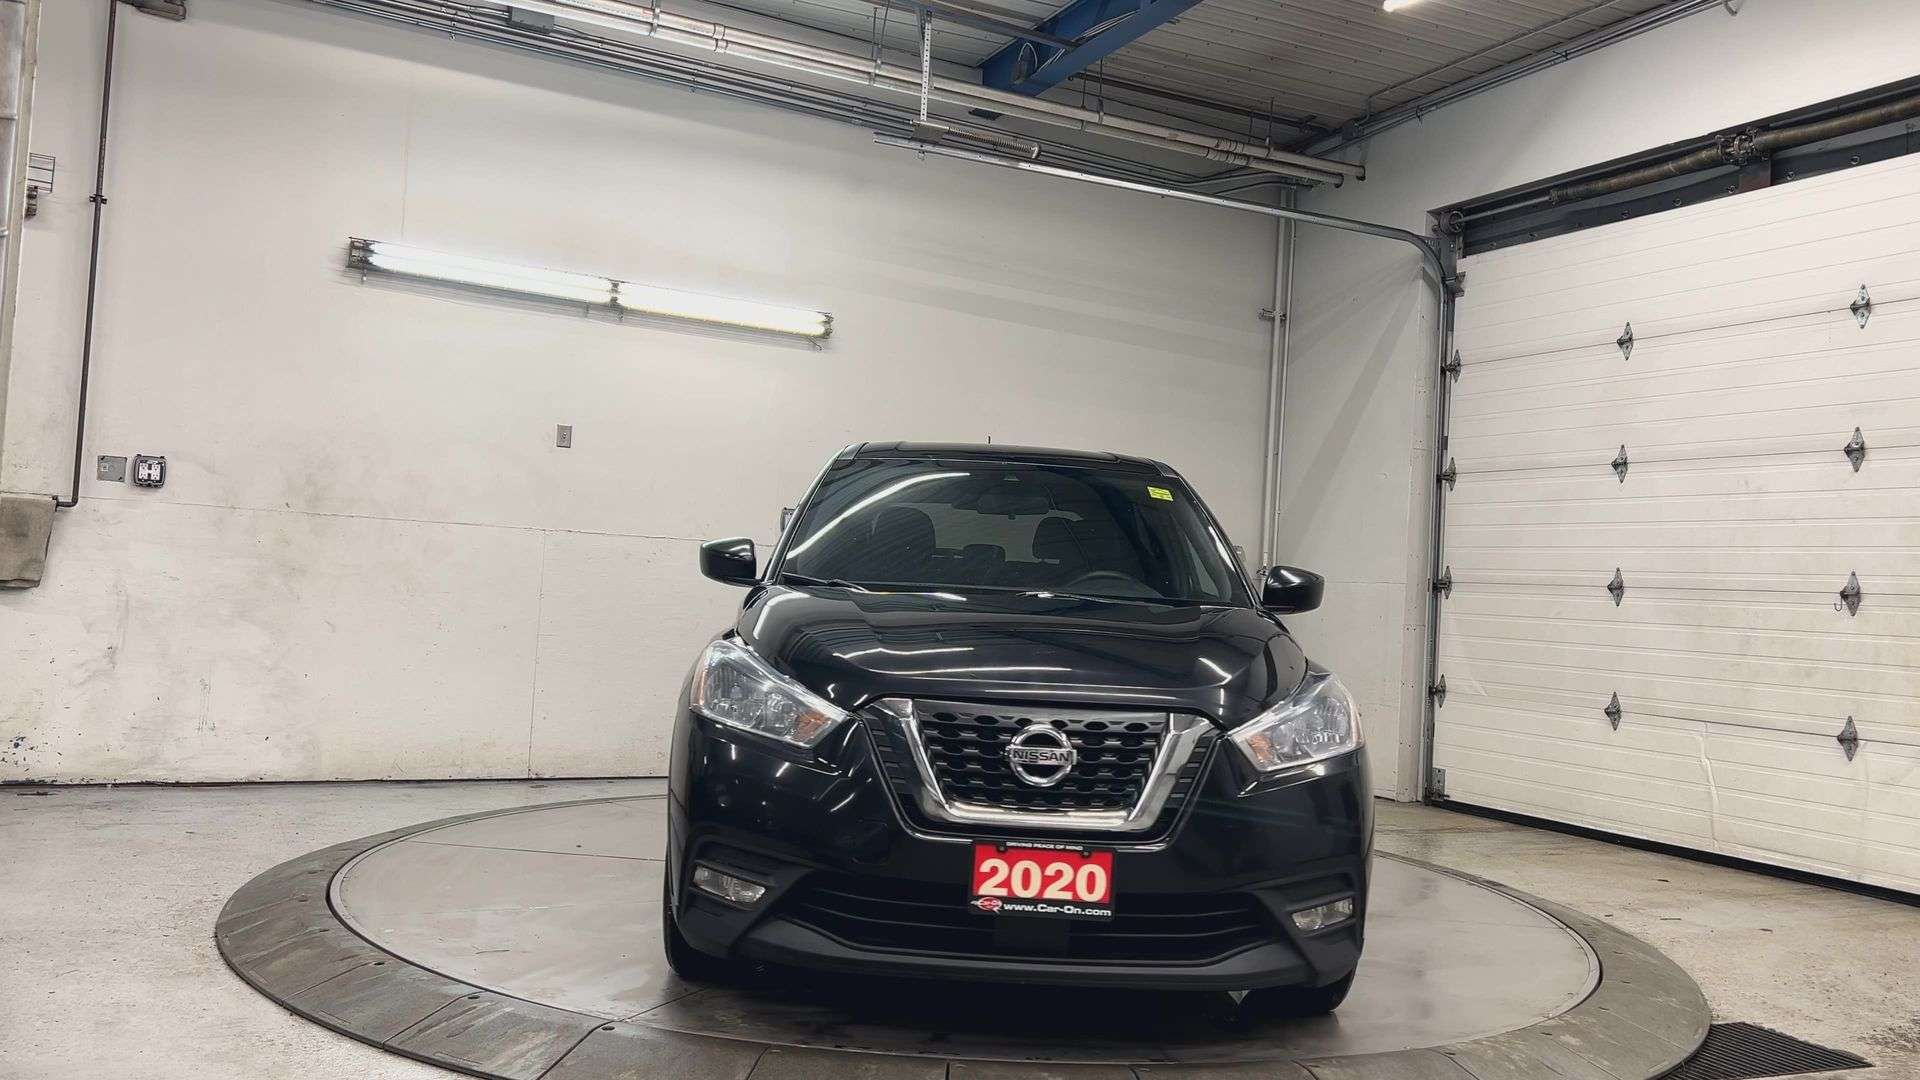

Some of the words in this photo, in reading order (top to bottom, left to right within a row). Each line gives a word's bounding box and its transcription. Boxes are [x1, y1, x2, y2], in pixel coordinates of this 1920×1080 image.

[1013, 750, 1070, 762] NISSAN
[978, 858, 1107, 902] 2020
[1003, 903, 1112, 917] www.Car-On.com
